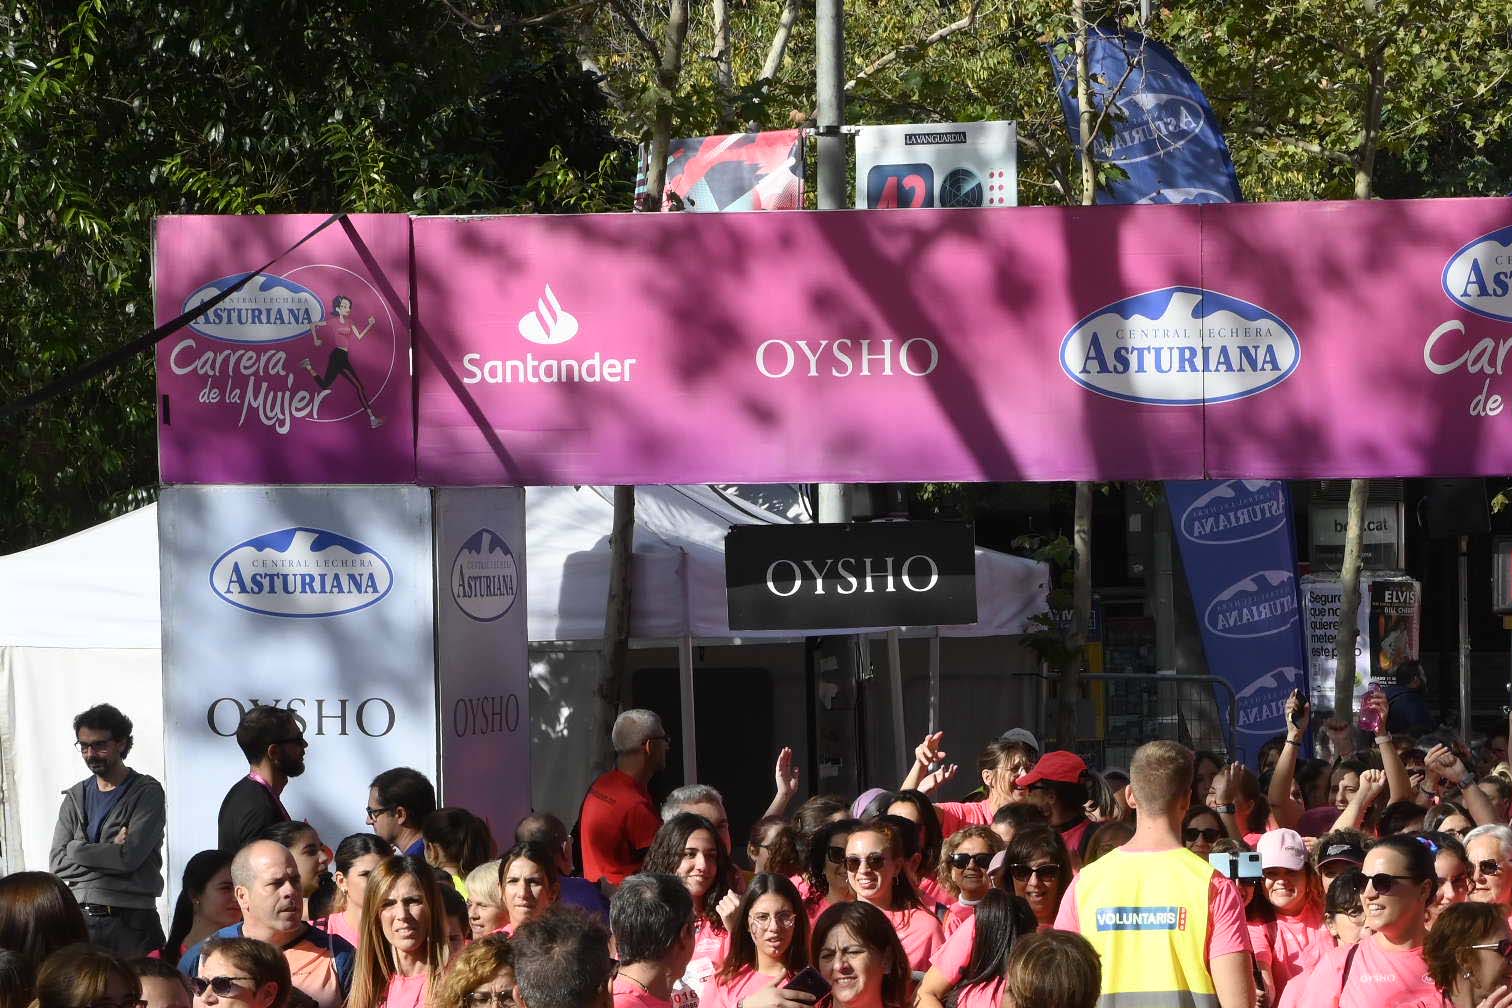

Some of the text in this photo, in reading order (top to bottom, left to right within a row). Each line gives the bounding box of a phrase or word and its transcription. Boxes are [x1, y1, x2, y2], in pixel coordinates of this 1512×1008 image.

[193, 298, 313, 325] ASTURIANA
[1116, 327, 1273, 340] CENTRAL LECHERA
[170, 339, 287, 376] Carrera
[462, 351, 637, 385] Santander
[756, 337, 939, 379] OYSHO
[1079, 331, 1282, 374] ASTURIANA
[199, 373, 332, 434] de la Mujer
[1469, 377, 1504, 417] de
[1335, 517, 1388, 533] b.cat
[224, 561, 380, 596] ASTURIANA
[252, 558, 373, 568] CENTRAL LECHERA
[766, 554, 939, 597] OYSHO
[457, 564, 514, 599] ASTURIANA
[1385, 590, 1415, 603] ELVIS
[1310, 607, 1326, 618] que
[1310, 620, 1342, 631] quiere
[1311, 646, 1330, 657] este
[207, 697, 396, 737] OSHO
[454, 693, 520, 738] OYSHO
[1097, 912, 1176, 926] VOLUNTARIS
